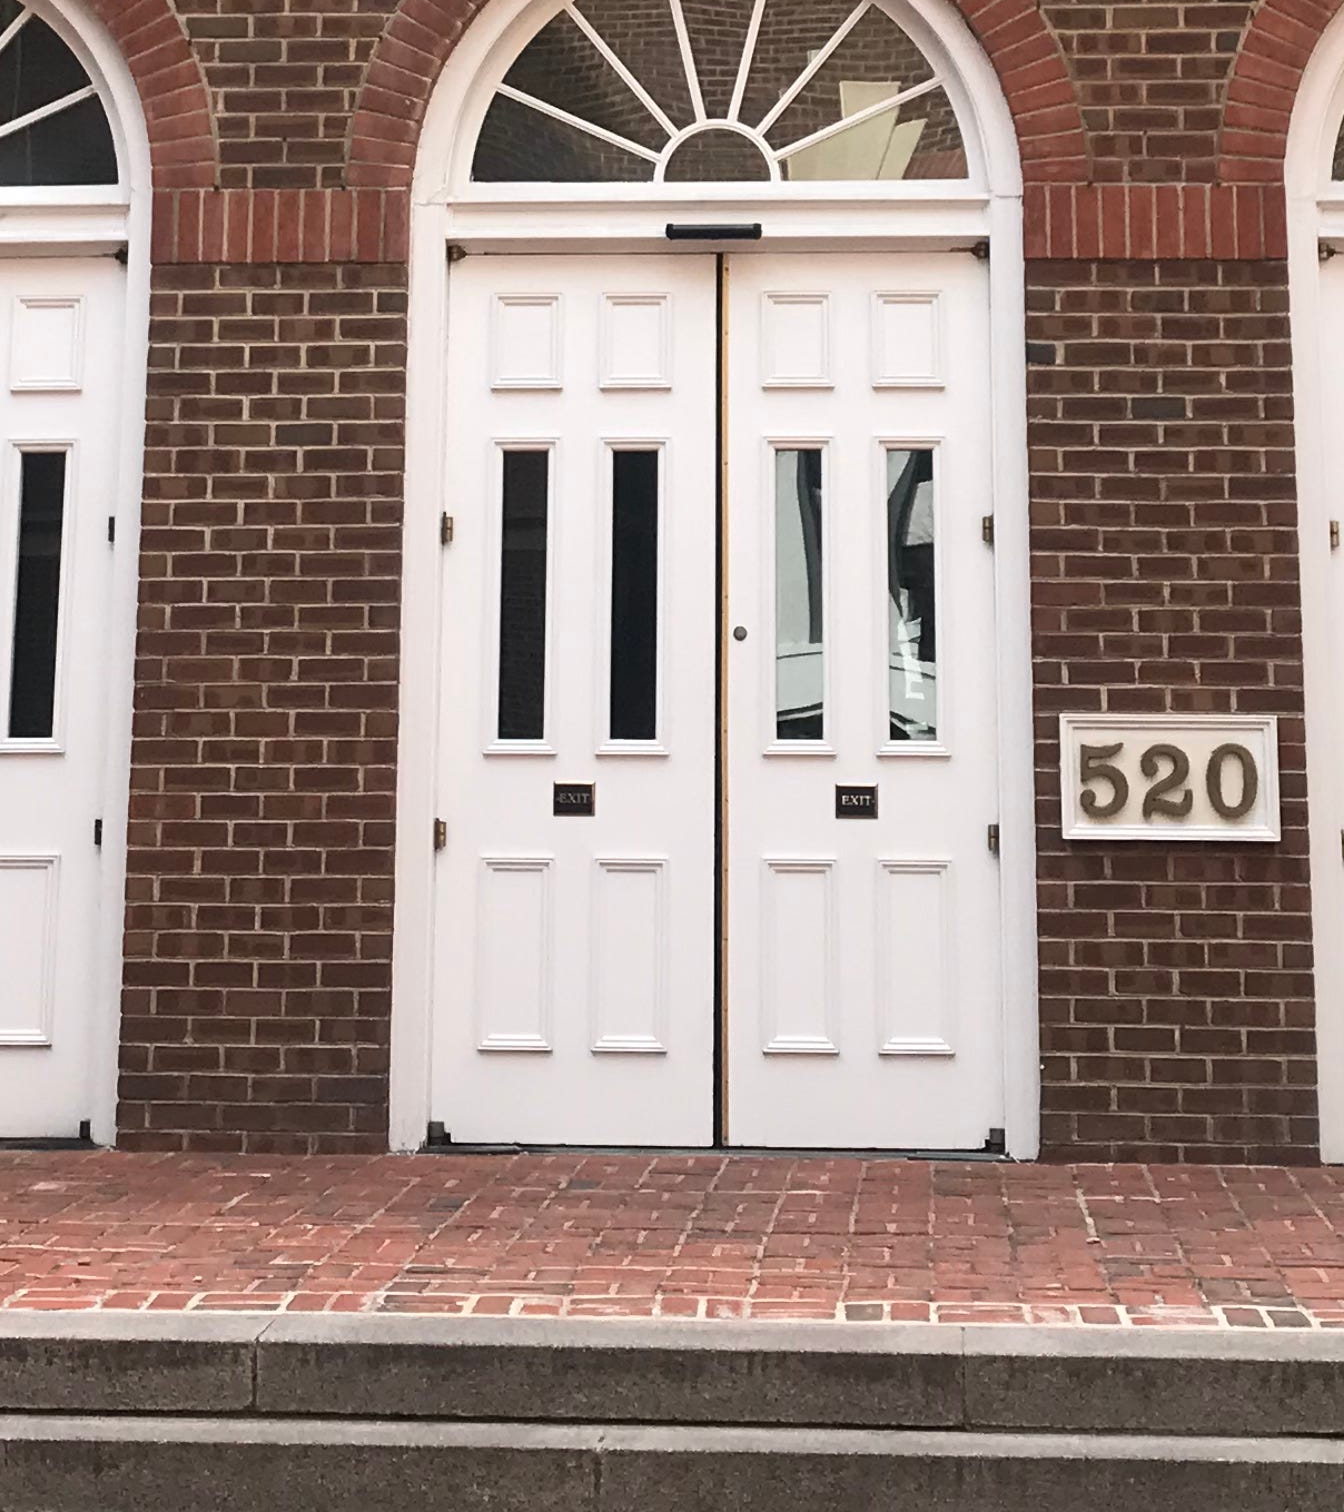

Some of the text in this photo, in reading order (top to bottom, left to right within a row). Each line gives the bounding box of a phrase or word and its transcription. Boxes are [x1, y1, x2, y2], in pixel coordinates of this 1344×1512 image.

[1079, 741, 1258, 822] 520
[559, 792, 590, 804] EXIT
[841, 794, 872, 806] EXIT
